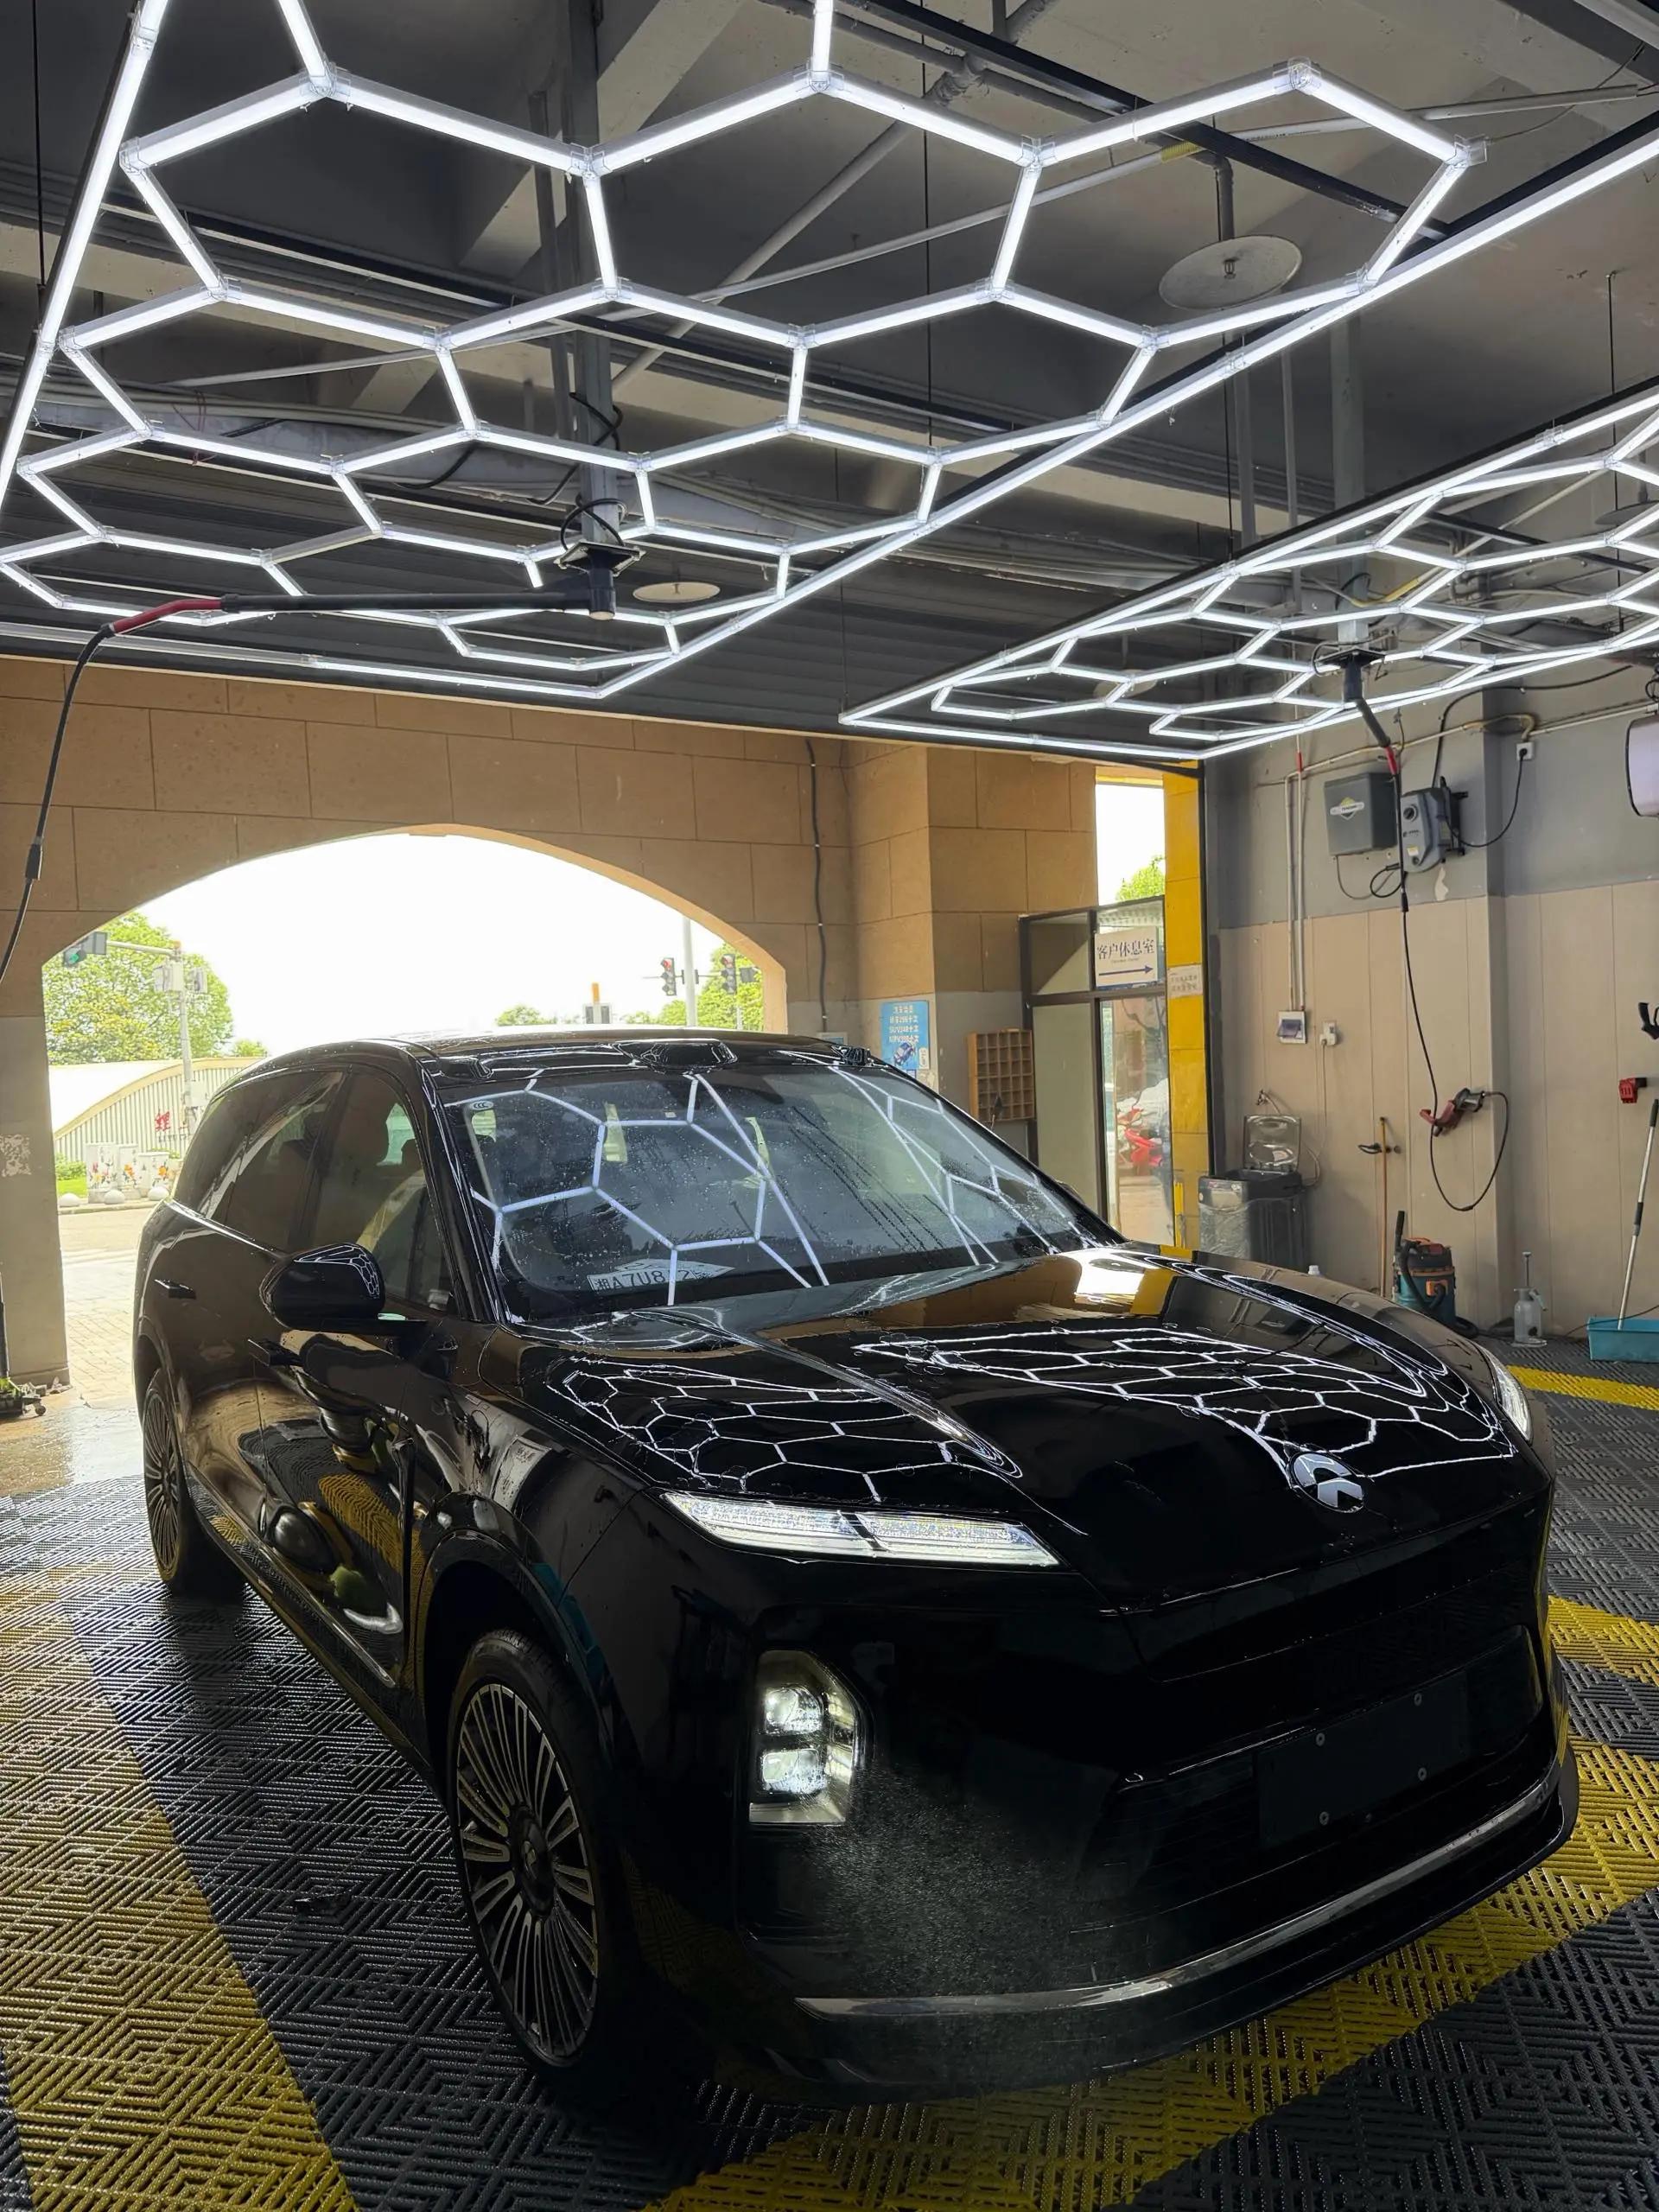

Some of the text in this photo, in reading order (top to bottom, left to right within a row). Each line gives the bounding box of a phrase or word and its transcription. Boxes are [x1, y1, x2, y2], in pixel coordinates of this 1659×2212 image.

[1096, 938, 1155, 960] 客户休息室
